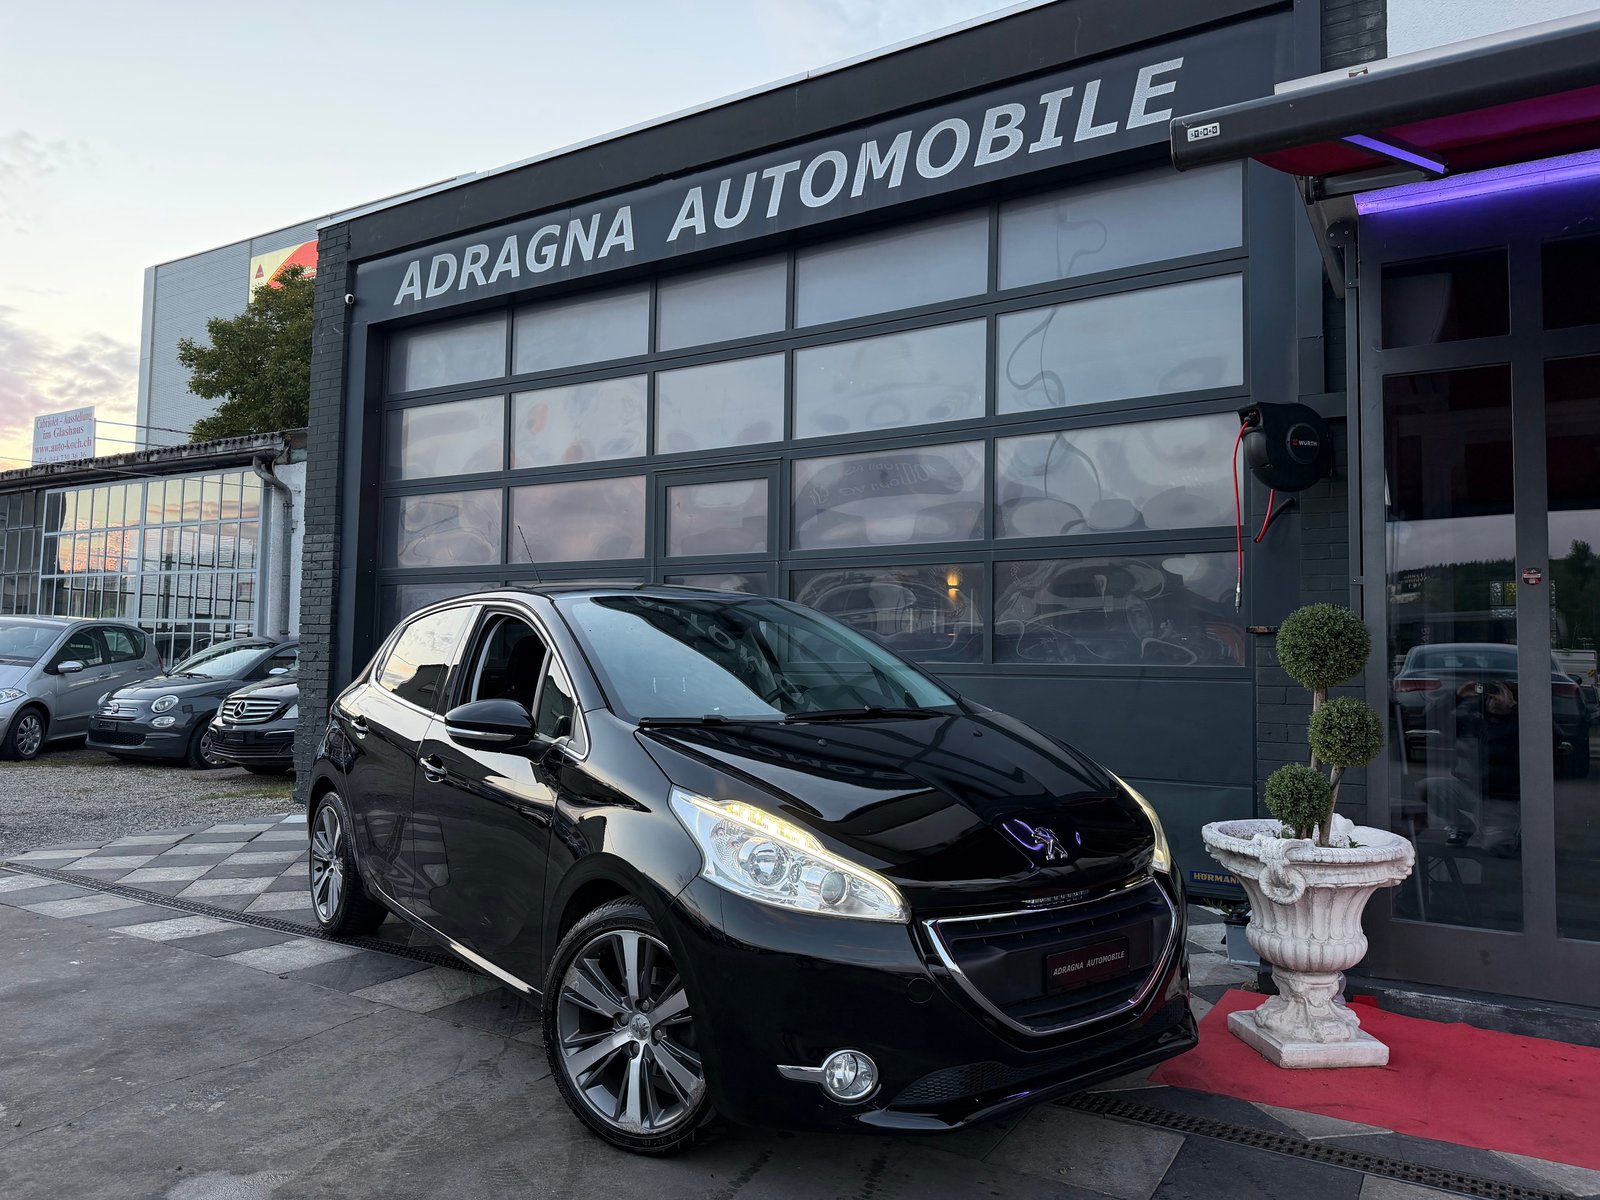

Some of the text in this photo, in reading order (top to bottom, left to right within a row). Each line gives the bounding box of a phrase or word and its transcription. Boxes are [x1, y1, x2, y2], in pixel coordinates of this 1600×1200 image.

[393, 57, 1184, 306] ADRAGNA AUTOMOBILE
[42, 426, 84, 440] im Glashaus
[34, 436, 92, 453] www.auto-koch.ch
[1053, 951, 1125, 976] ADRAGNA AUTOMOBILE
